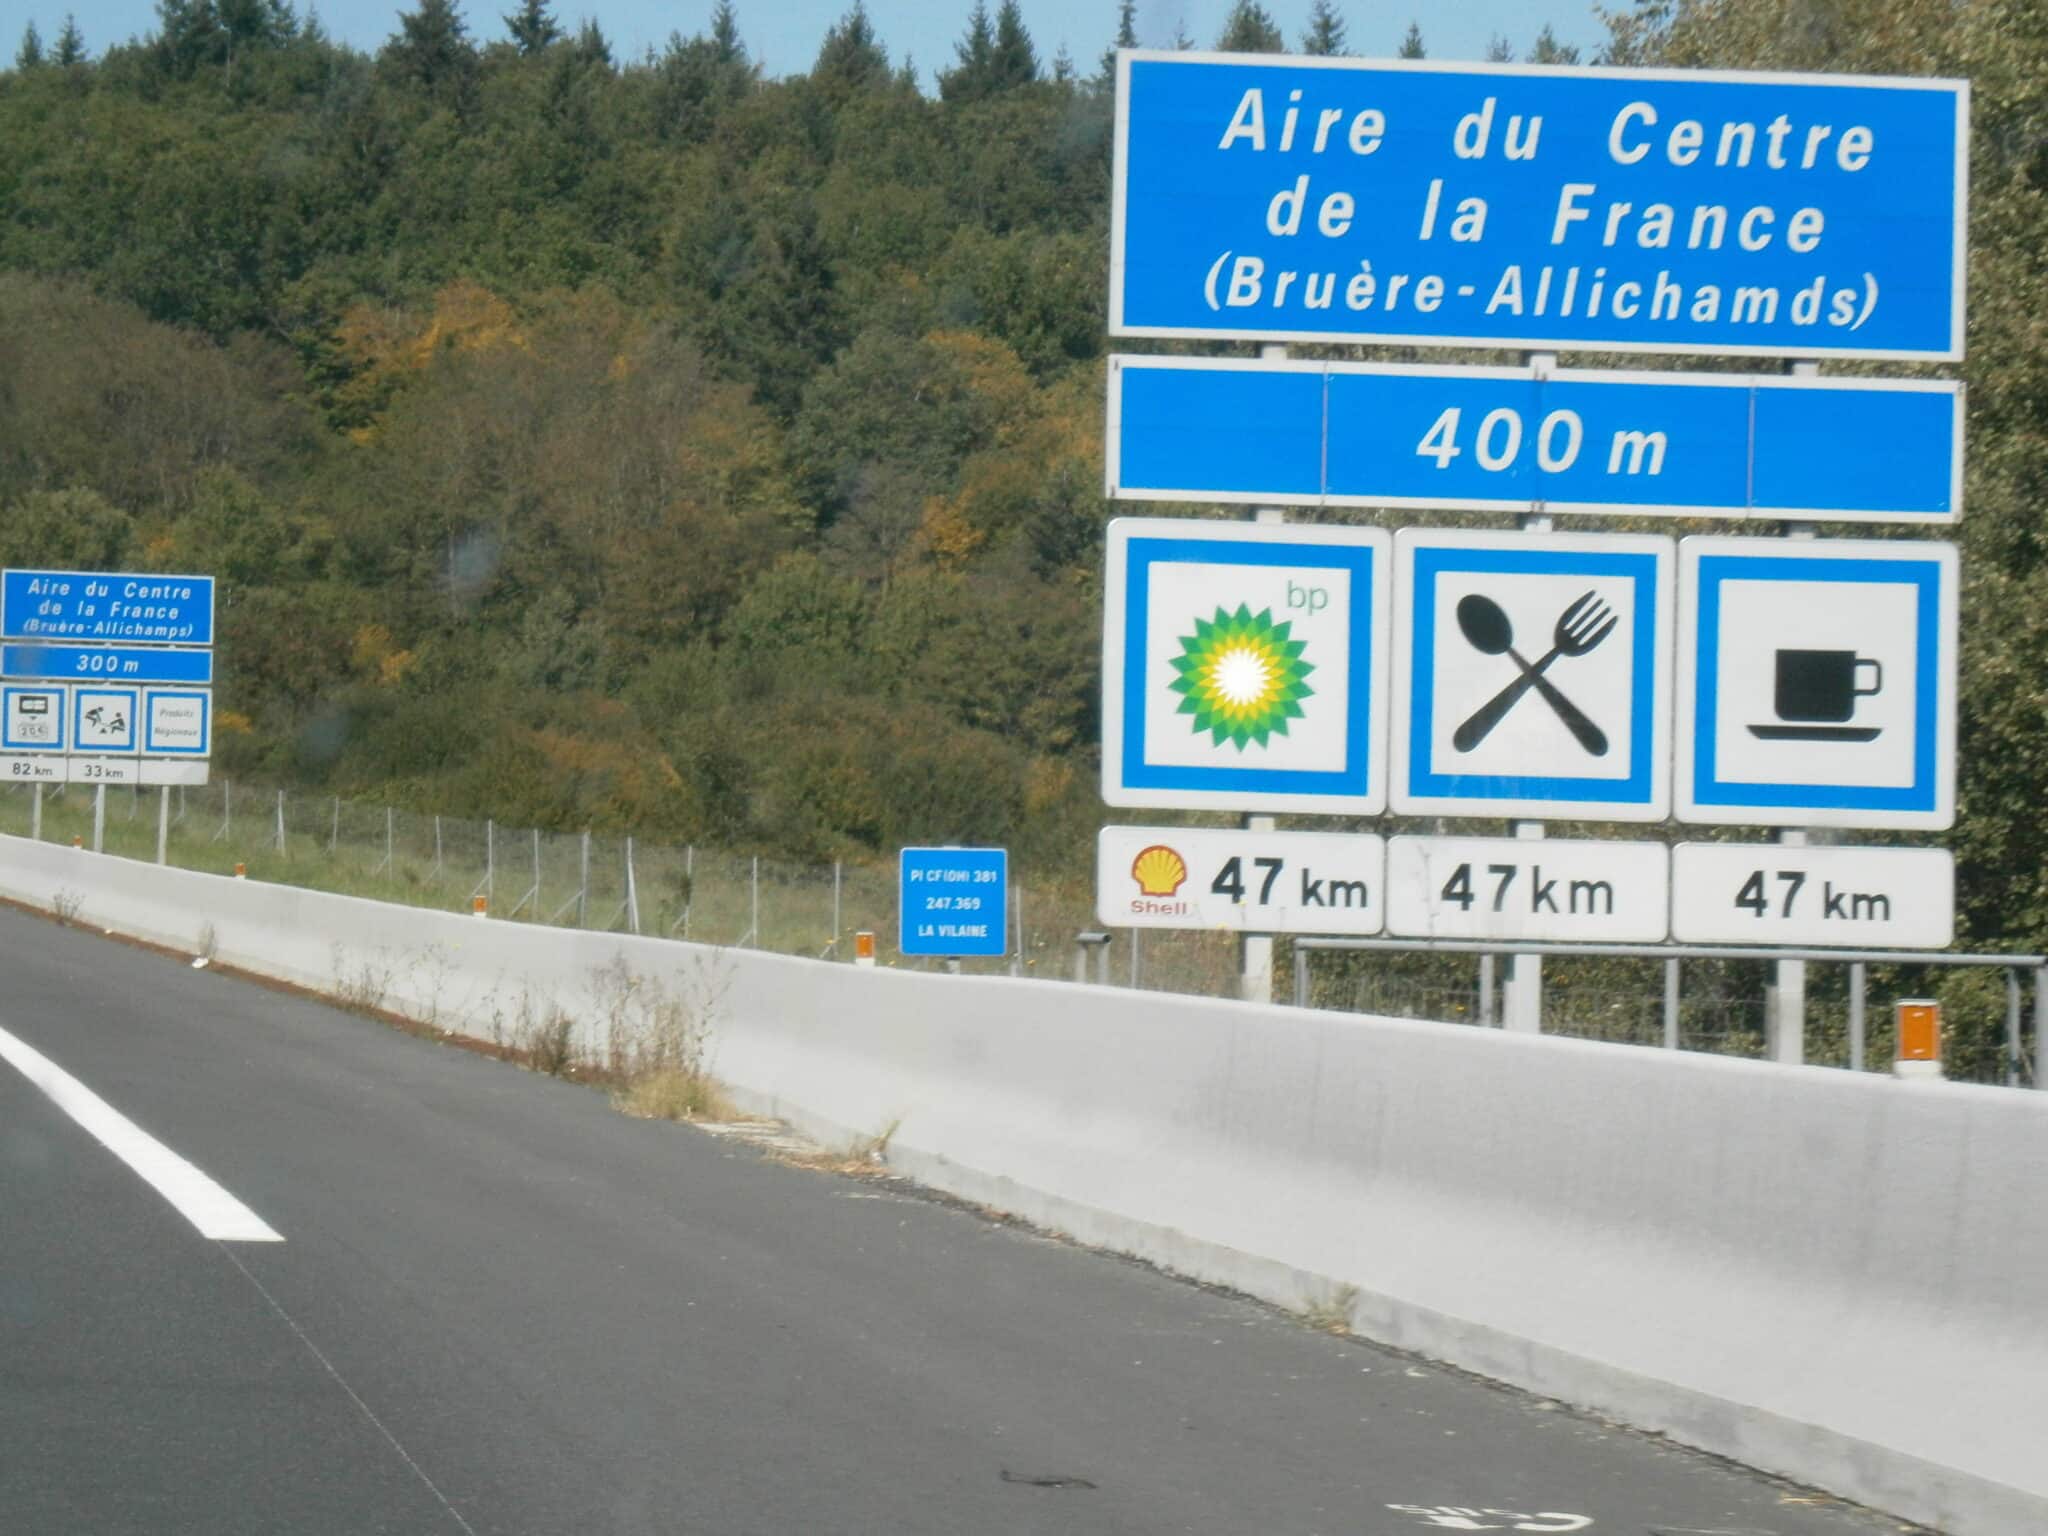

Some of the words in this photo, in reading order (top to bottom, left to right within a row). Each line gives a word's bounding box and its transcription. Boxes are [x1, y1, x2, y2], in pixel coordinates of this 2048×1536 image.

[1219, 88, 1386, 155] Aire
[1454, 97, 1543, 160] du
[1609, 101, 1874, 171] Centre
[1266, 174, 1356, 238] de
[1420, 179, 1489, 242] la
[1551, 183, 1825, 253] France
[1205, 251, 1879, 330] (Bruère-Allichamds)
[1416, 406, 1583, 473] 400
[1606, 431, 1668, 475] m
[28, 579, 70, 596] Aire
[86, 582, 109, 597] du
[124, 583, 192, 600] Centre
[1287, 581, 1329, 615] bp
[39, 600, 62, 616] de
[78, 602, 96, 617] la
[110, 602, 179, 620] France
[76, 655, 118, 672] 300
[123, 661, 139, 672] m
[12, 763, 31, 776] 82
[34, 764, 53, 776] km
[84, 765, 102, 777] 33
[105, 767, 124, 778] km
[1211, 856, 1285, 905] 47
[1301, 868, 1368, 908] km
[1441, 863, 1518, 912] 47
[1531, 865, 1613, 914] km
[1735, 870, 1807, 918] 47
[1822, 881, 1890, 921] km
[1131, 900, 1188, 914] Shell
[918, 924, 934, 937] LA
[938, 924, 988, 937] VILAINE
